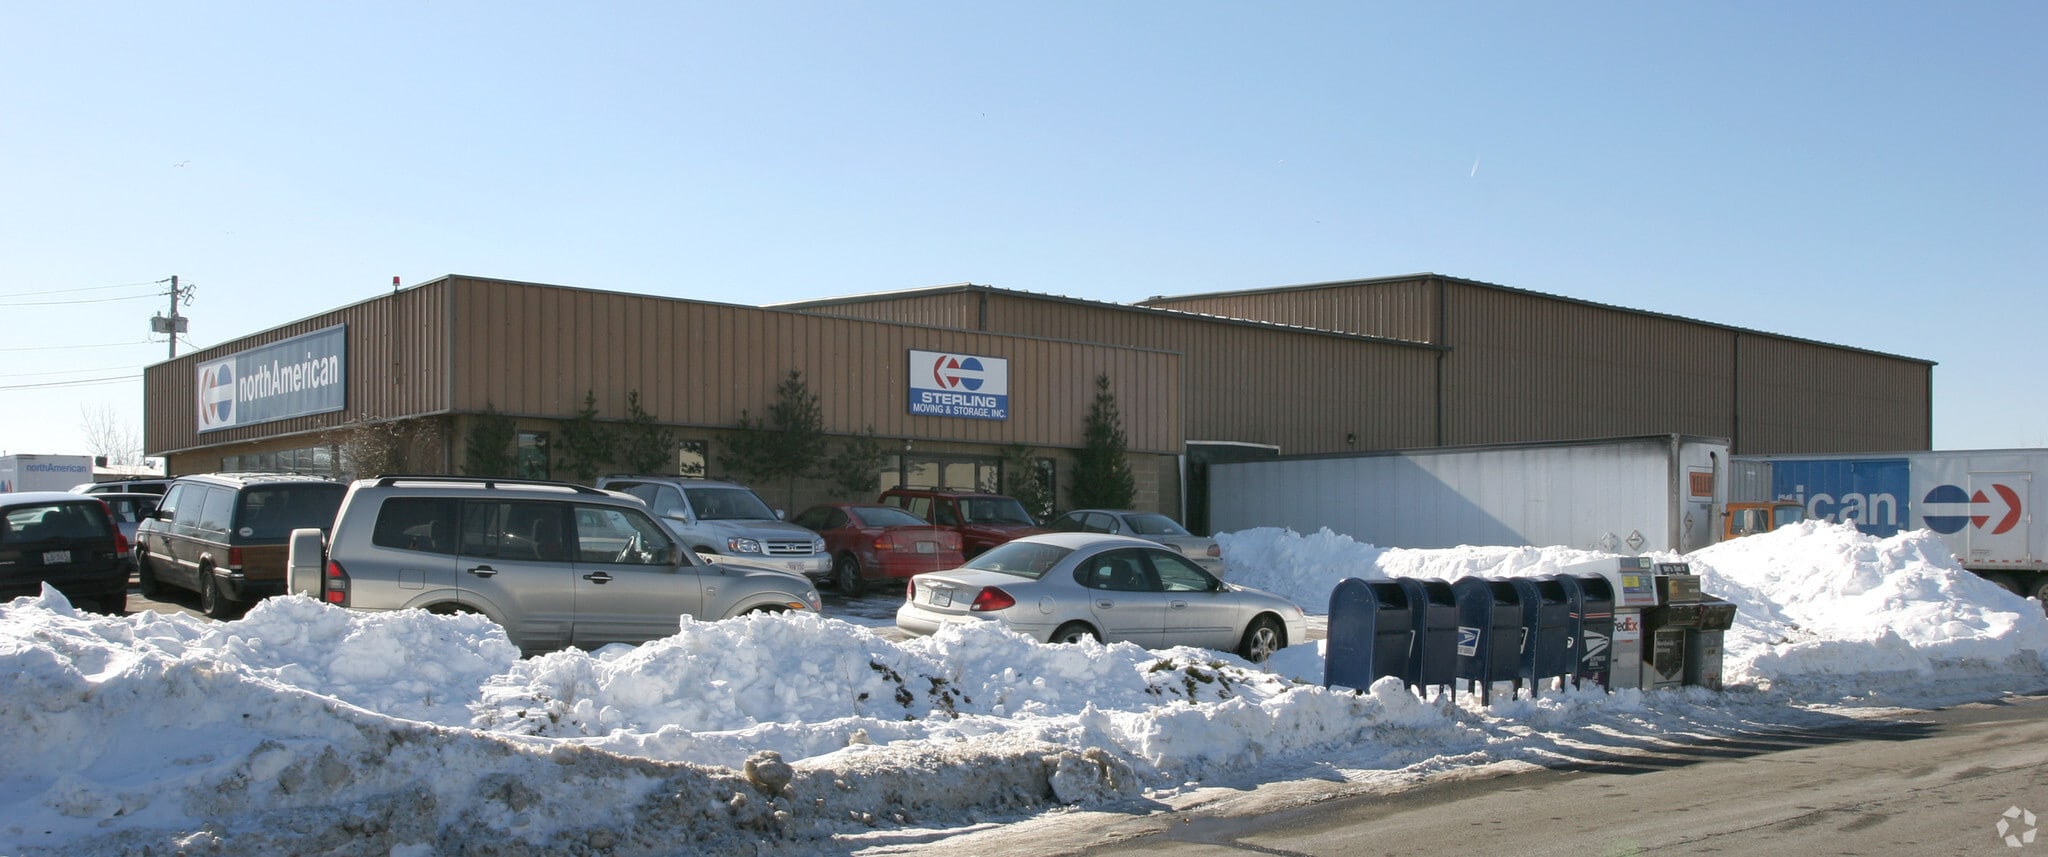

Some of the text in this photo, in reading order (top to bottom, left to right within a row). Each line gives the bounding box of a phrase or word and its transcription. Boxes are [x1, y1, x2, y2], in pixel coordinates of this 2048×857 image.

[239, 351, 338, 403] northAmerican
[921, 392, 997, 408] STERLING
[913, 403, 1007, 418] MOVING & STORAGE, INC.
[26, 463, 87, 473] northAmerican
[1778, 484, 1897, 526] ican
[1614, 616, 1638, 632] edEx
